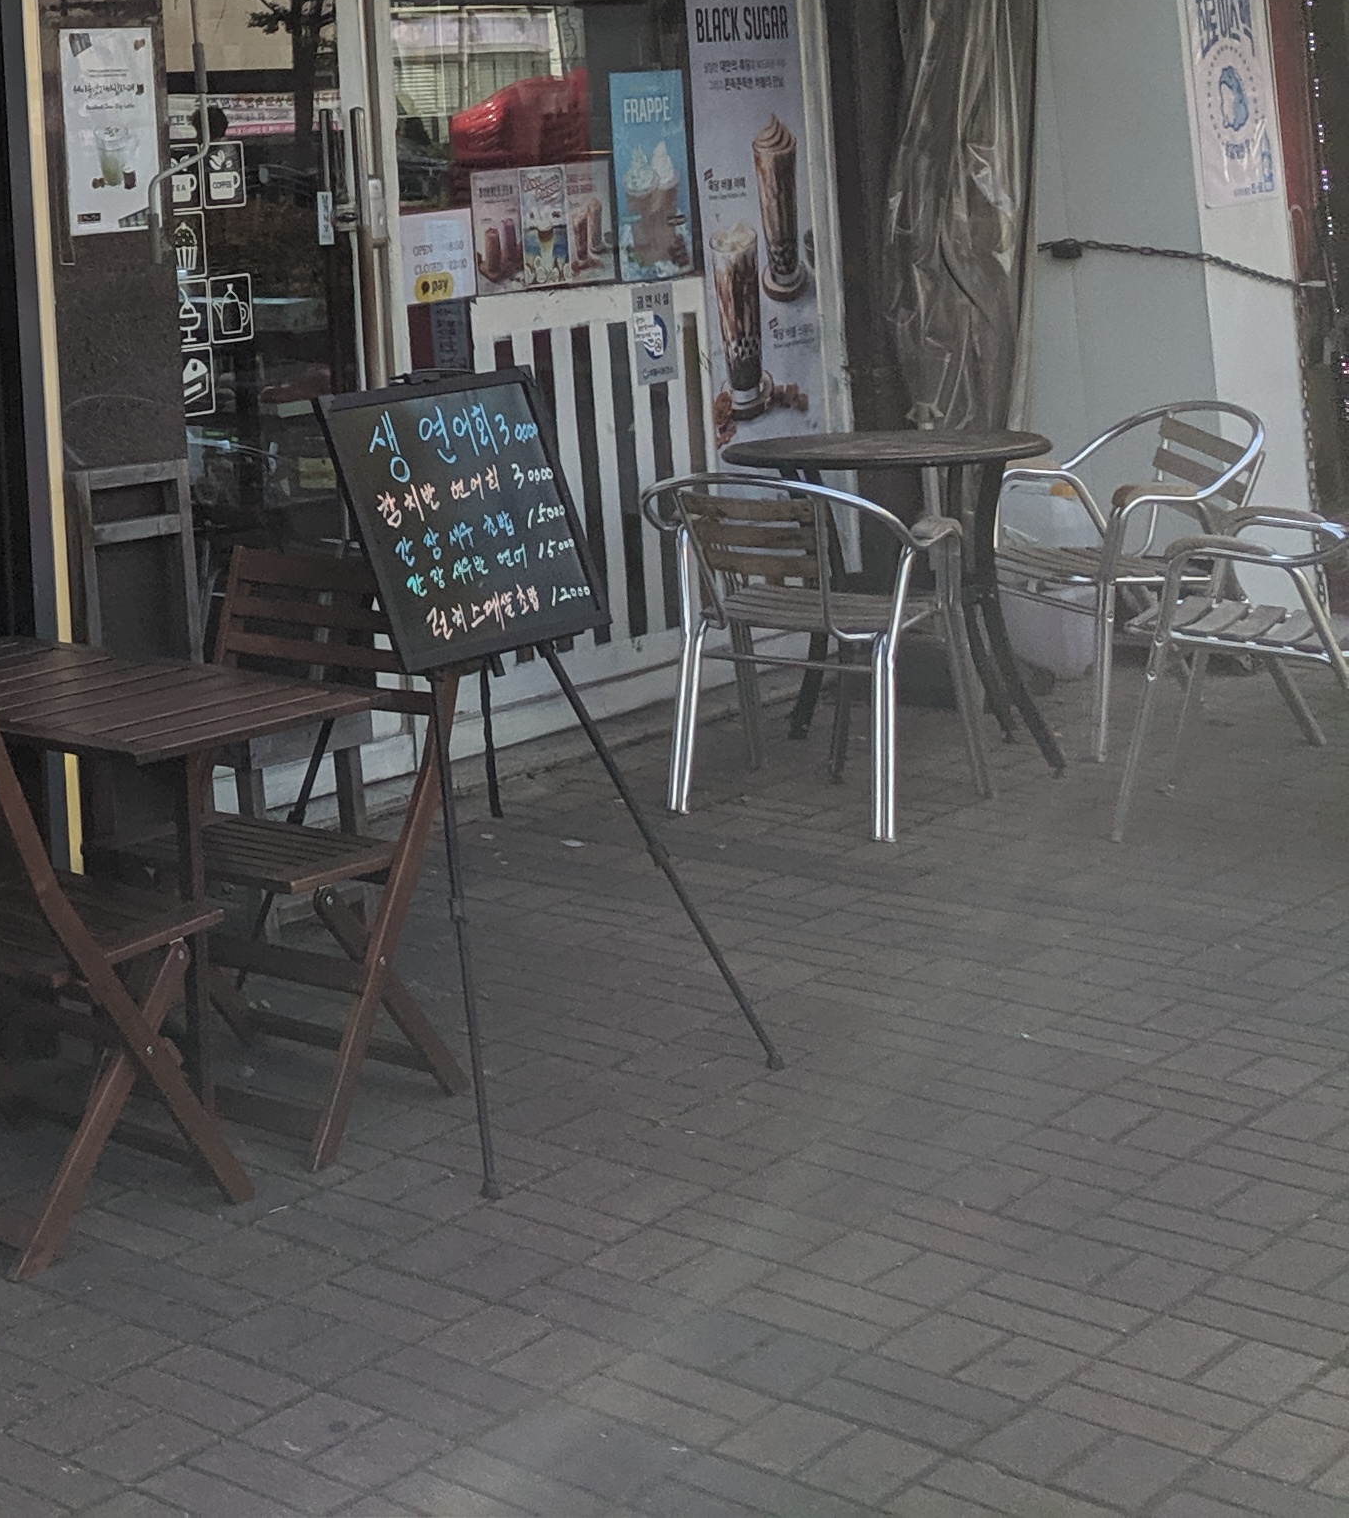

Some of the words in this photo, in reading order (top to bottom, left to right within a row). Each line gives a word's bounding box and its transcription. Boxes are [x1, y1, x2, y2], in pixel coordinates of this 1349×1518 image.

[695, 7, 740, 42] BLACK
[743, 5, 788, 40] SUGAR
[623, 95, 671, 123] FRAPPE
[212, 180, 232, 189] COFFEE
[369, 410, 411, 483] 생
[419, 402, 500, 464] 연어회
[451, 464, 501, 501] 연어회
[496, 542, 529, 569] 연어
